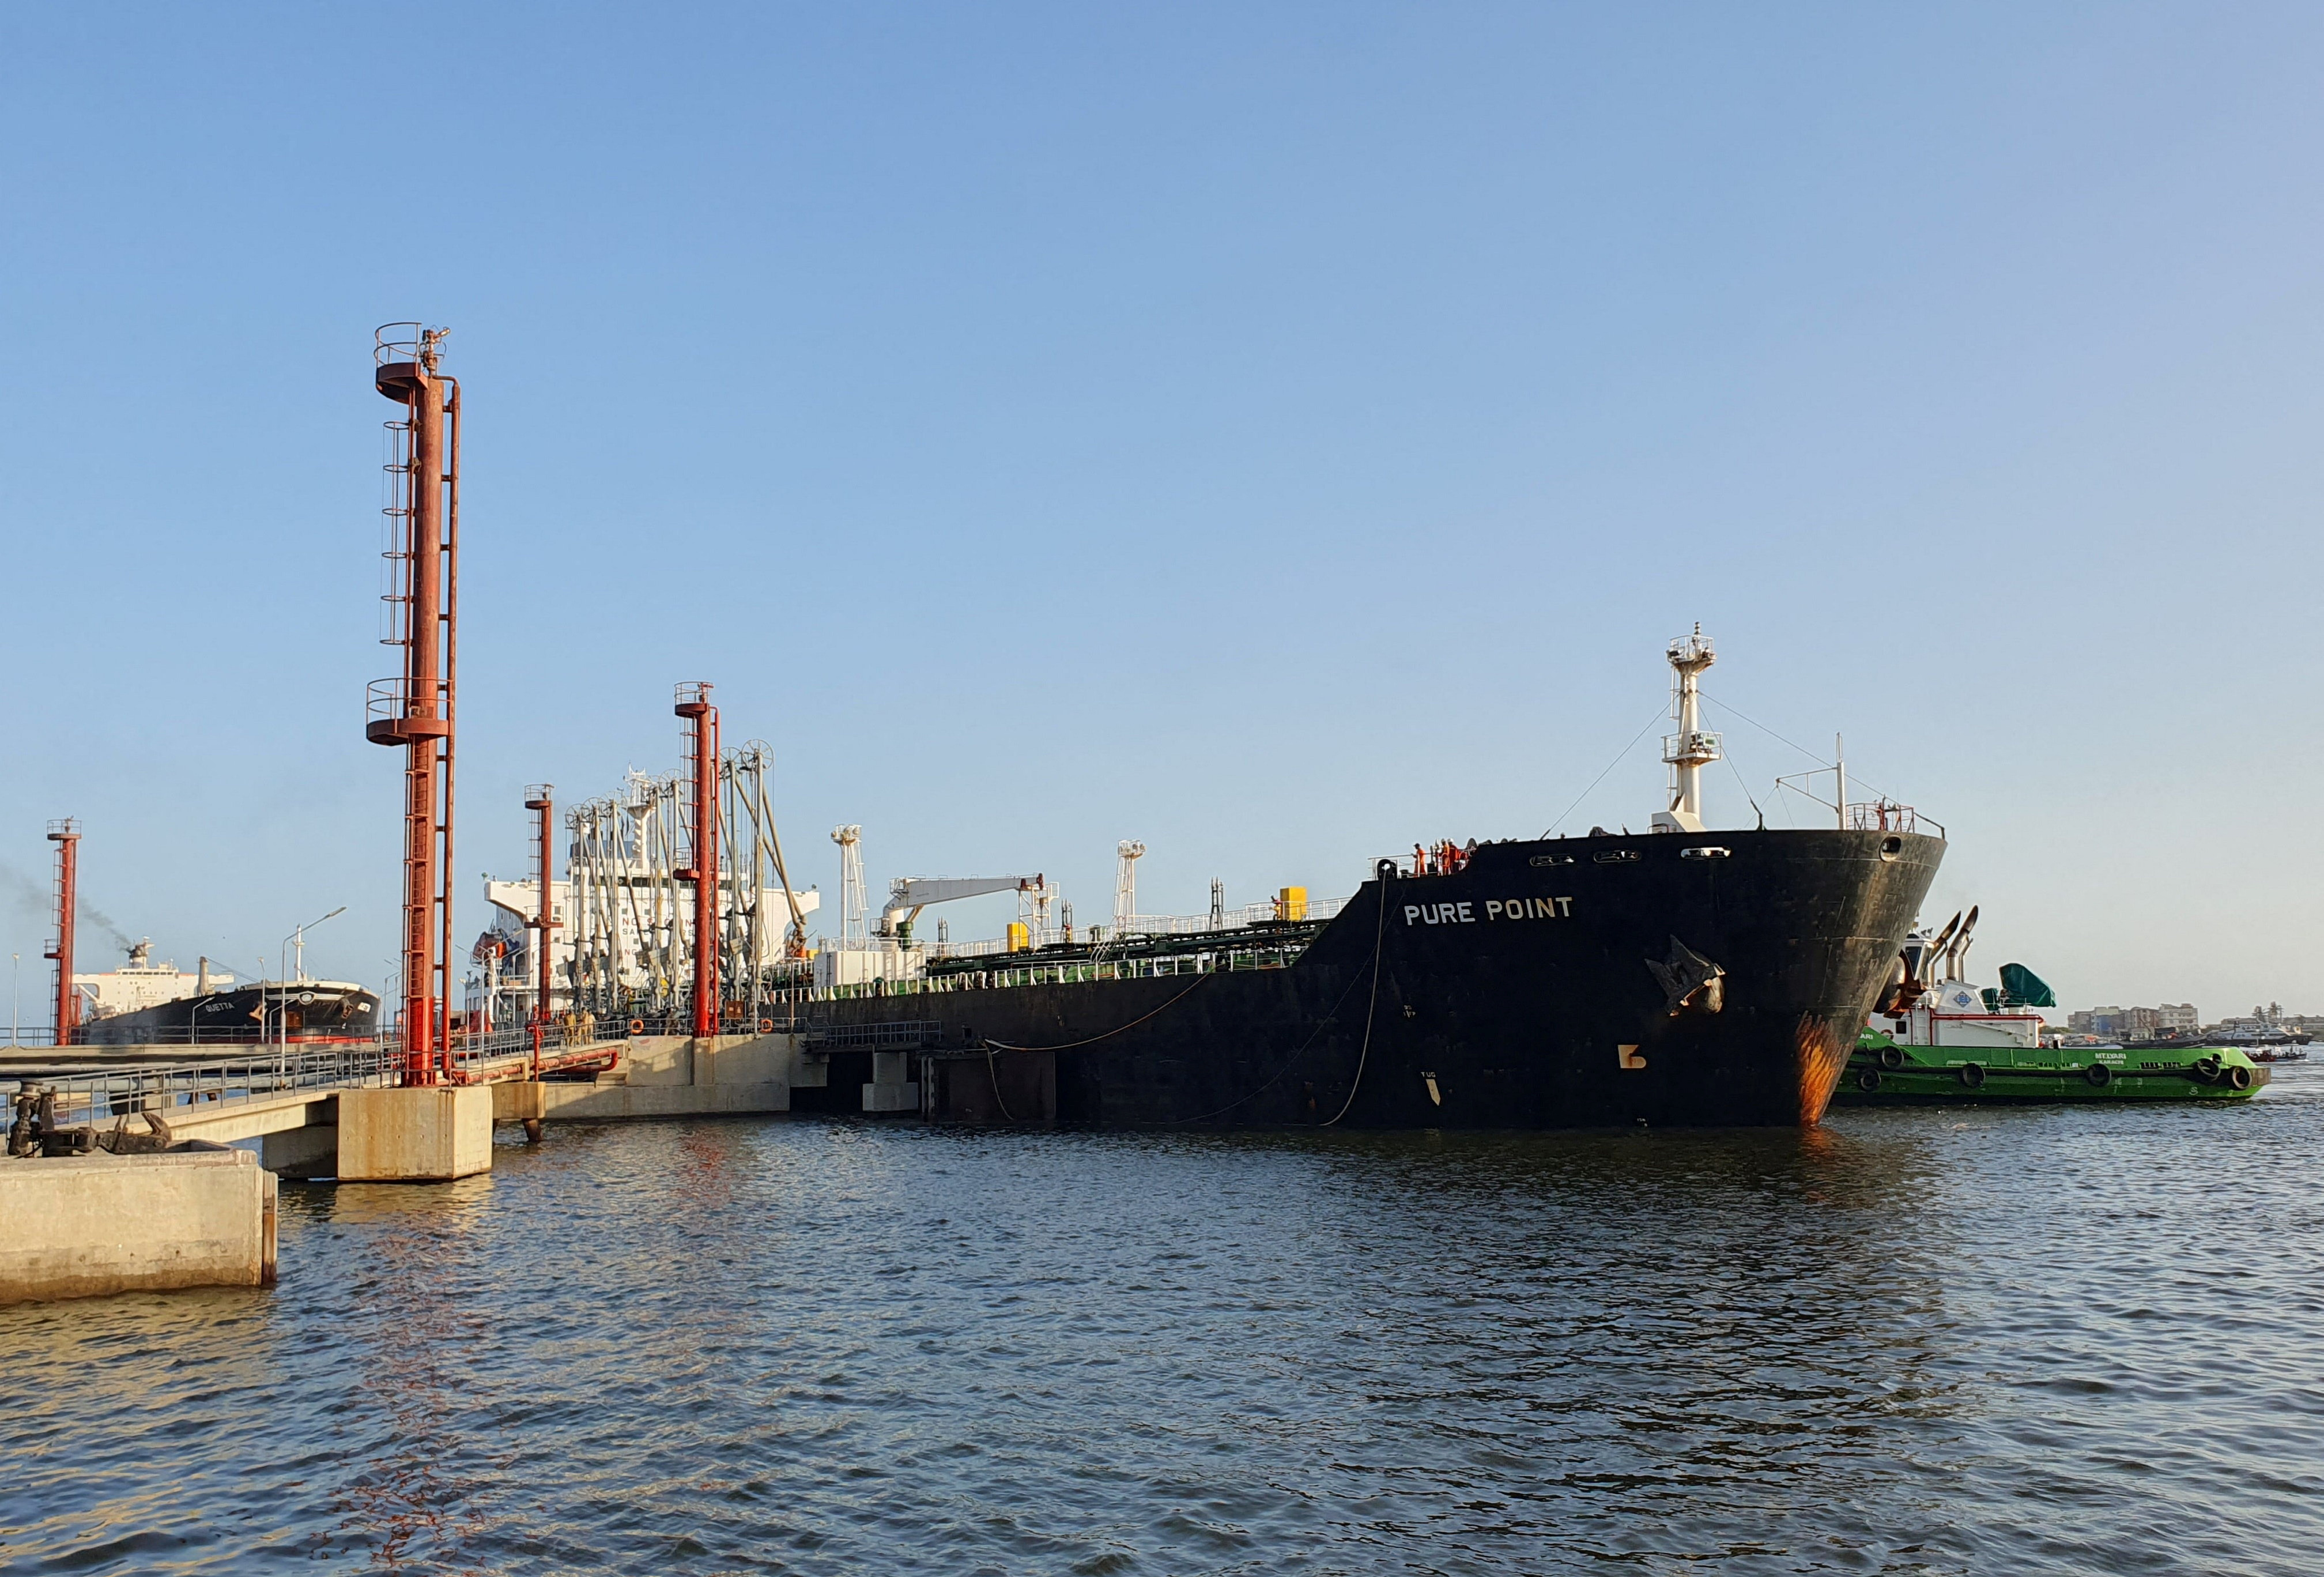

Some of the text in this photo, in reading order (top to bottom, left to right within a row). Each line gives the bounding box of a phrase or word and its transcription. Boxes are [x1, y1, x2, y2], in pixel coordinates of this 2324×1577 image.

[1404, 896, 1573, 926] PURE POINT
[205, 1002, 235, 1012] QUETTA
